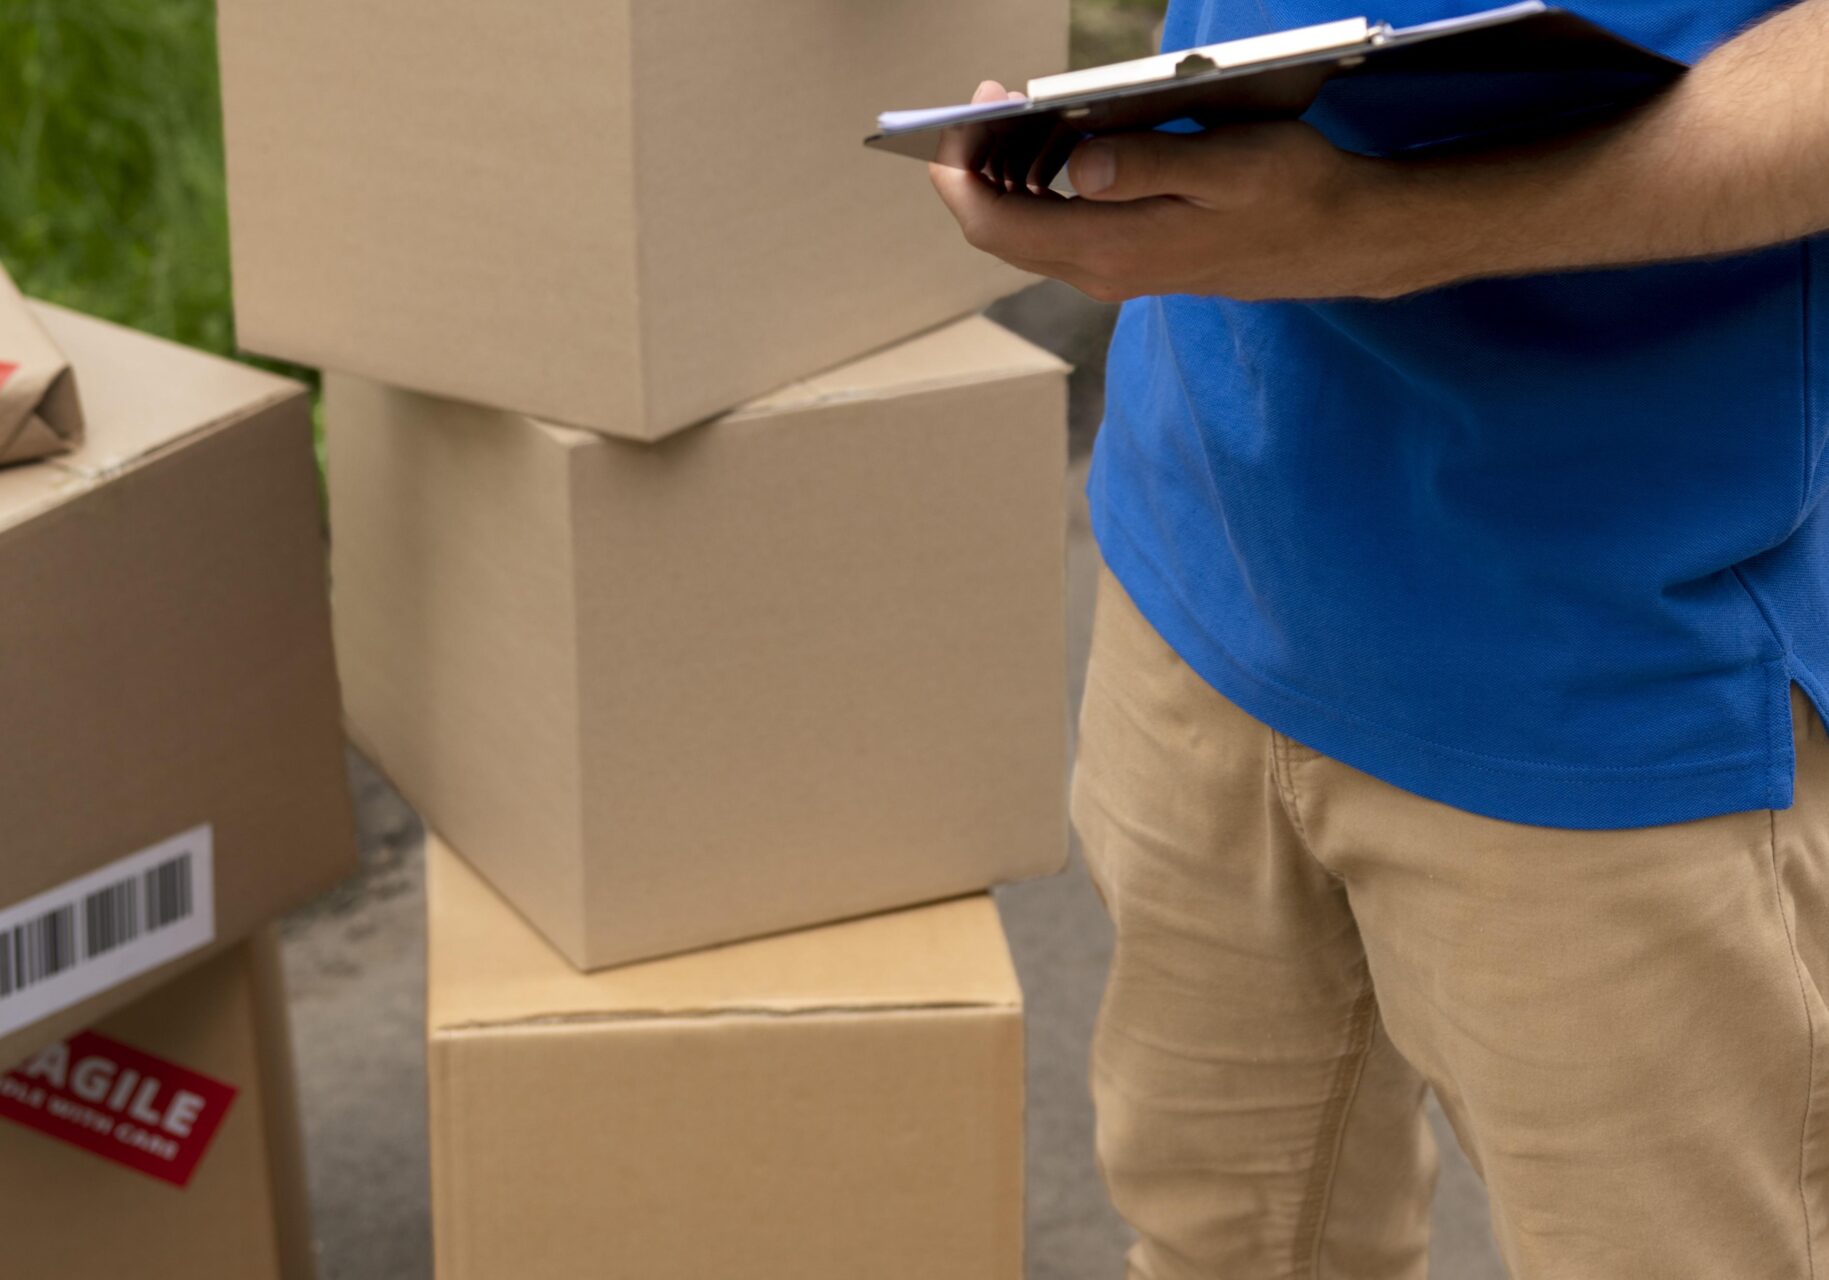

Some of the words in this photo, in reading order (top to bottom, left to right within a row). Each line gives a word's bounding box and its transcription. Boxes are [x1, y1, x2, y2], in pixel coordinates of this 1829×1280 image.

[26, 1040, 206, 1138] AGILE
[47, 1094, 114, 1135] WITH
[113, 1122, 180, 1161] CARE
